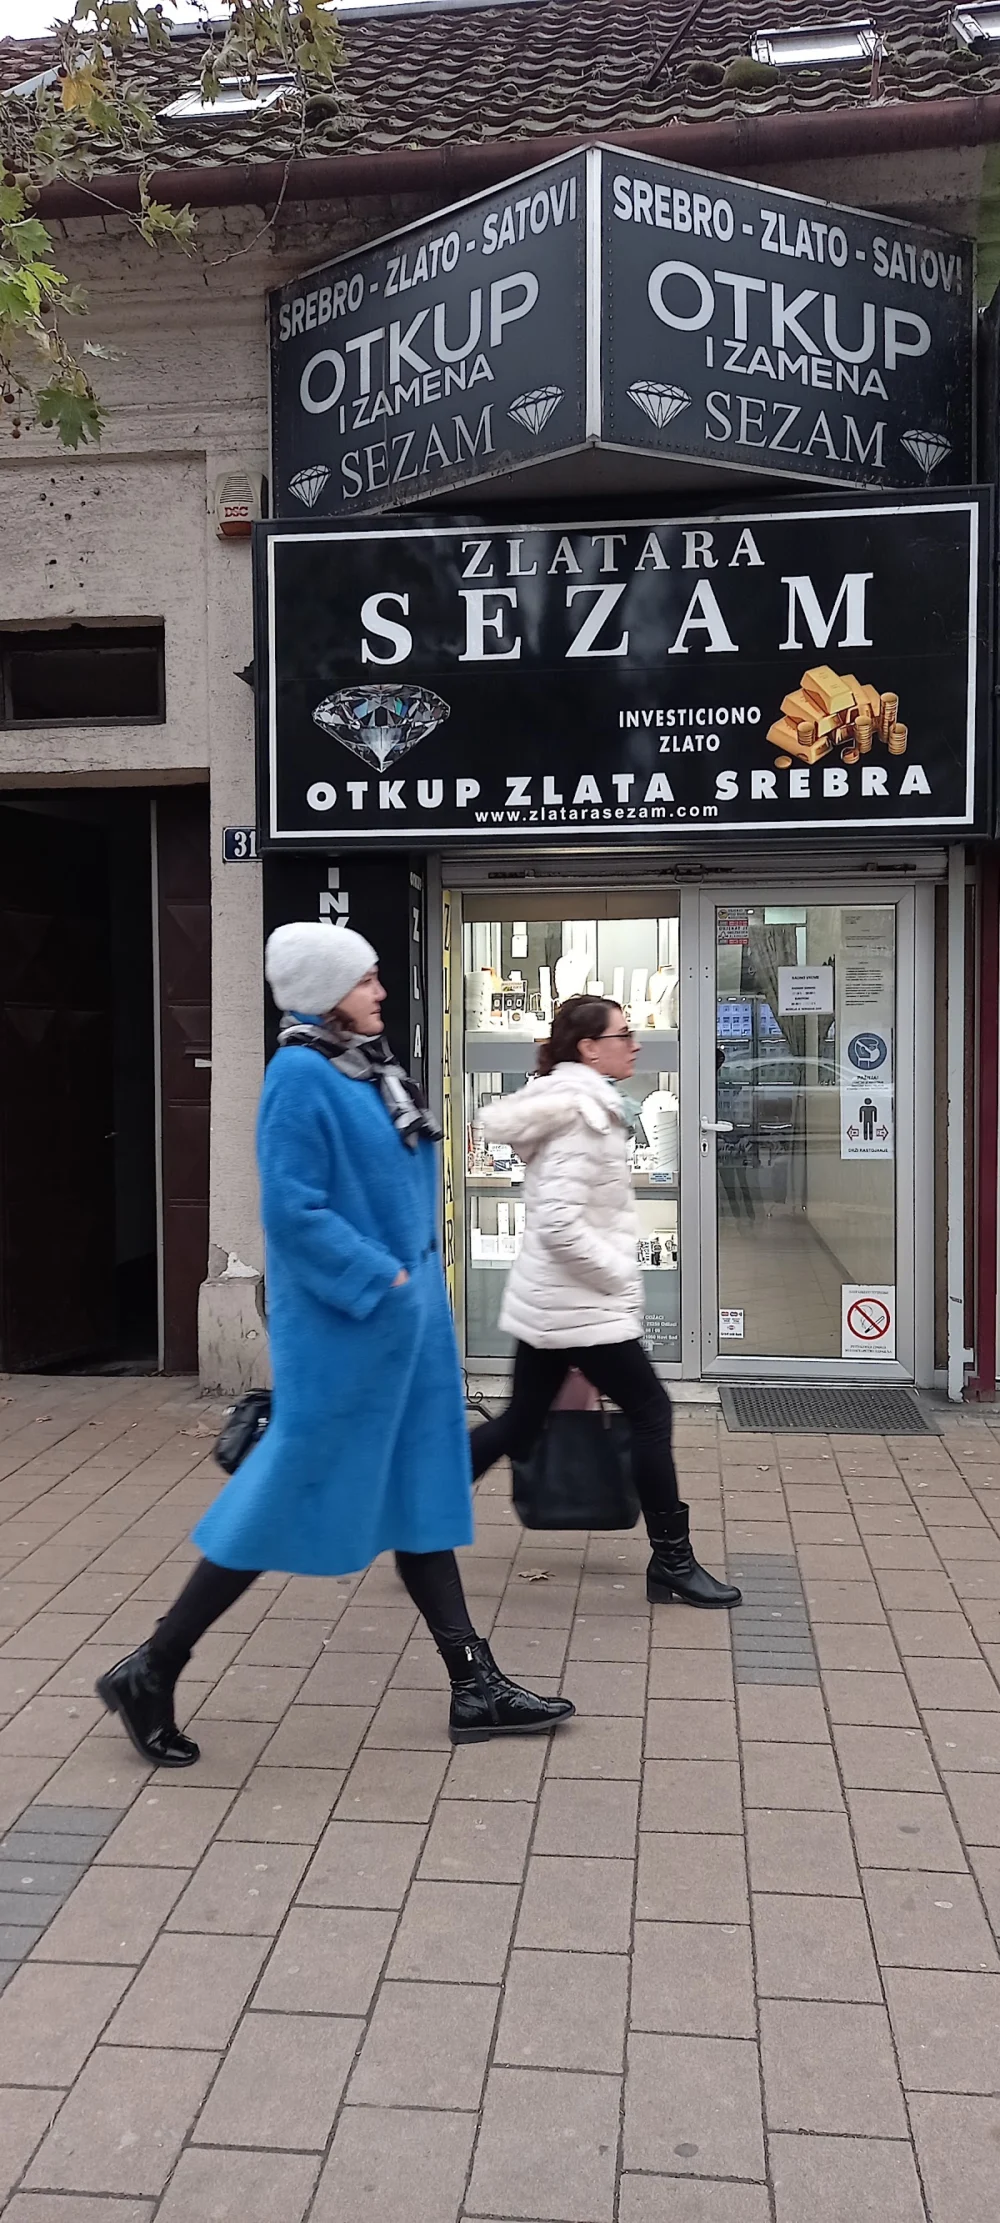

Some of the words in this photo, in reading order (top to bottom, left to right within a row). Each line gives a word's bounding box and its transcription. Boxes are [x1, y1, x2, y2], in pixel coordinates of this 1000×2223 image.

[278, 273, 364, 342] SREBRO
[384, 236, 460, 298] ZLATO
[481, 176, 577, 255] SATOVI
[613, 174, 734, 242] SREBRO
[760, 208, 848, 267] ZLATO
[872, 236, 963, 296] SATOVI
[300, 271, 540, 414] OTKUP
[647, 260, 931, 371] OTKUP
[339, 405, 346, 434] I
[352, 353, 495, 430] ZAMENA
[706, 335, 714, 368] I
[723, 339, 889, 401] ZAMENA
[341, 403, 496, 499] SEZAM
[705, 391, 887, 468] SEZAM
[225, 506, 248, 517] DSC
[461, 528, 765, 578] ZLATARA
[360, 572, 874, 665] SEZAM
[619, 709, 762, 728] INVESTICIONO
[659, 734, 720, 753] ZLATO
[306, 779, 481, 811] OTKUP
[504, 773, 675, 806] ZLATA
[714, 764, 932, 801] SREBRA
[474, 805, 719, 823] www.zlatarasezam.com
[234, 831, 257, 857] 31
